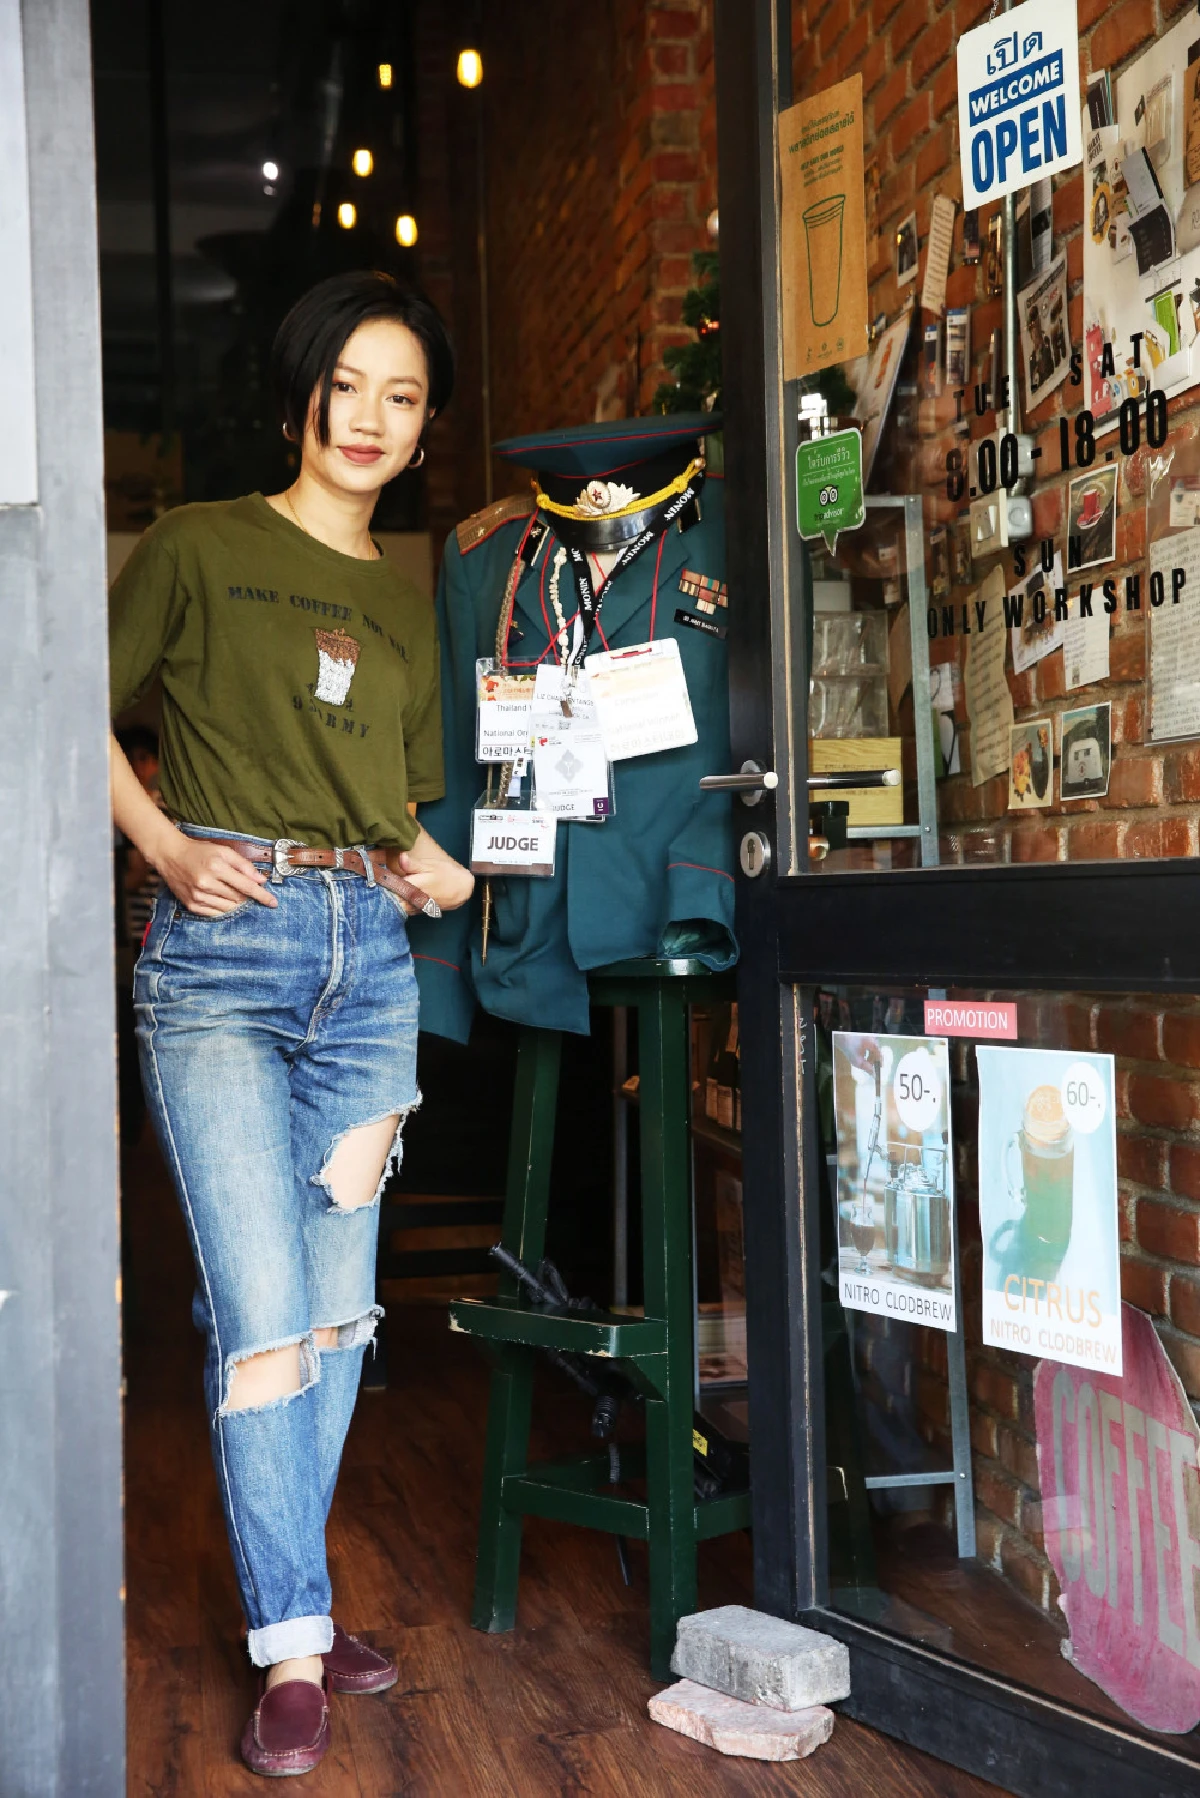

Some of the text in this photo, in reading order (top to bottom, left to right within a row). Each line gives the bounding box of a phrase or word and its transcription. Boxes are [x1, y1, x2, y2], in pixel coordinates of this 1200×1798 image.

[987, 31, 1042, 75] เปิด
[971, 60, 1060, 117] WELCOME
[971, 93, 1068, 193] OPEN
[1070, 332, 1144, 386] SAT
[1014, 536, 1082, 577] SUN
[228, 586, 279, 603] MAKE
[290, 595, 353, 621] COFFEE
[927, 568, 1186, 639] ONLY WORKSHOP
[496, 704, 526, 712] Thailand
[483, 729, 514, 737] National
[487, 836, 539, 852] JUDGE
[927, 1008, 1008, 1030] PROMOTION
[844, 1283, 952, 1321] NITRO CLODBREW
[1004, 1273, 1102, 1328] CITRUS
[990, 1318, 1117, 1364] NITRO CLODBREW
[1053, 1370, 1200, 1671] COFFEE
